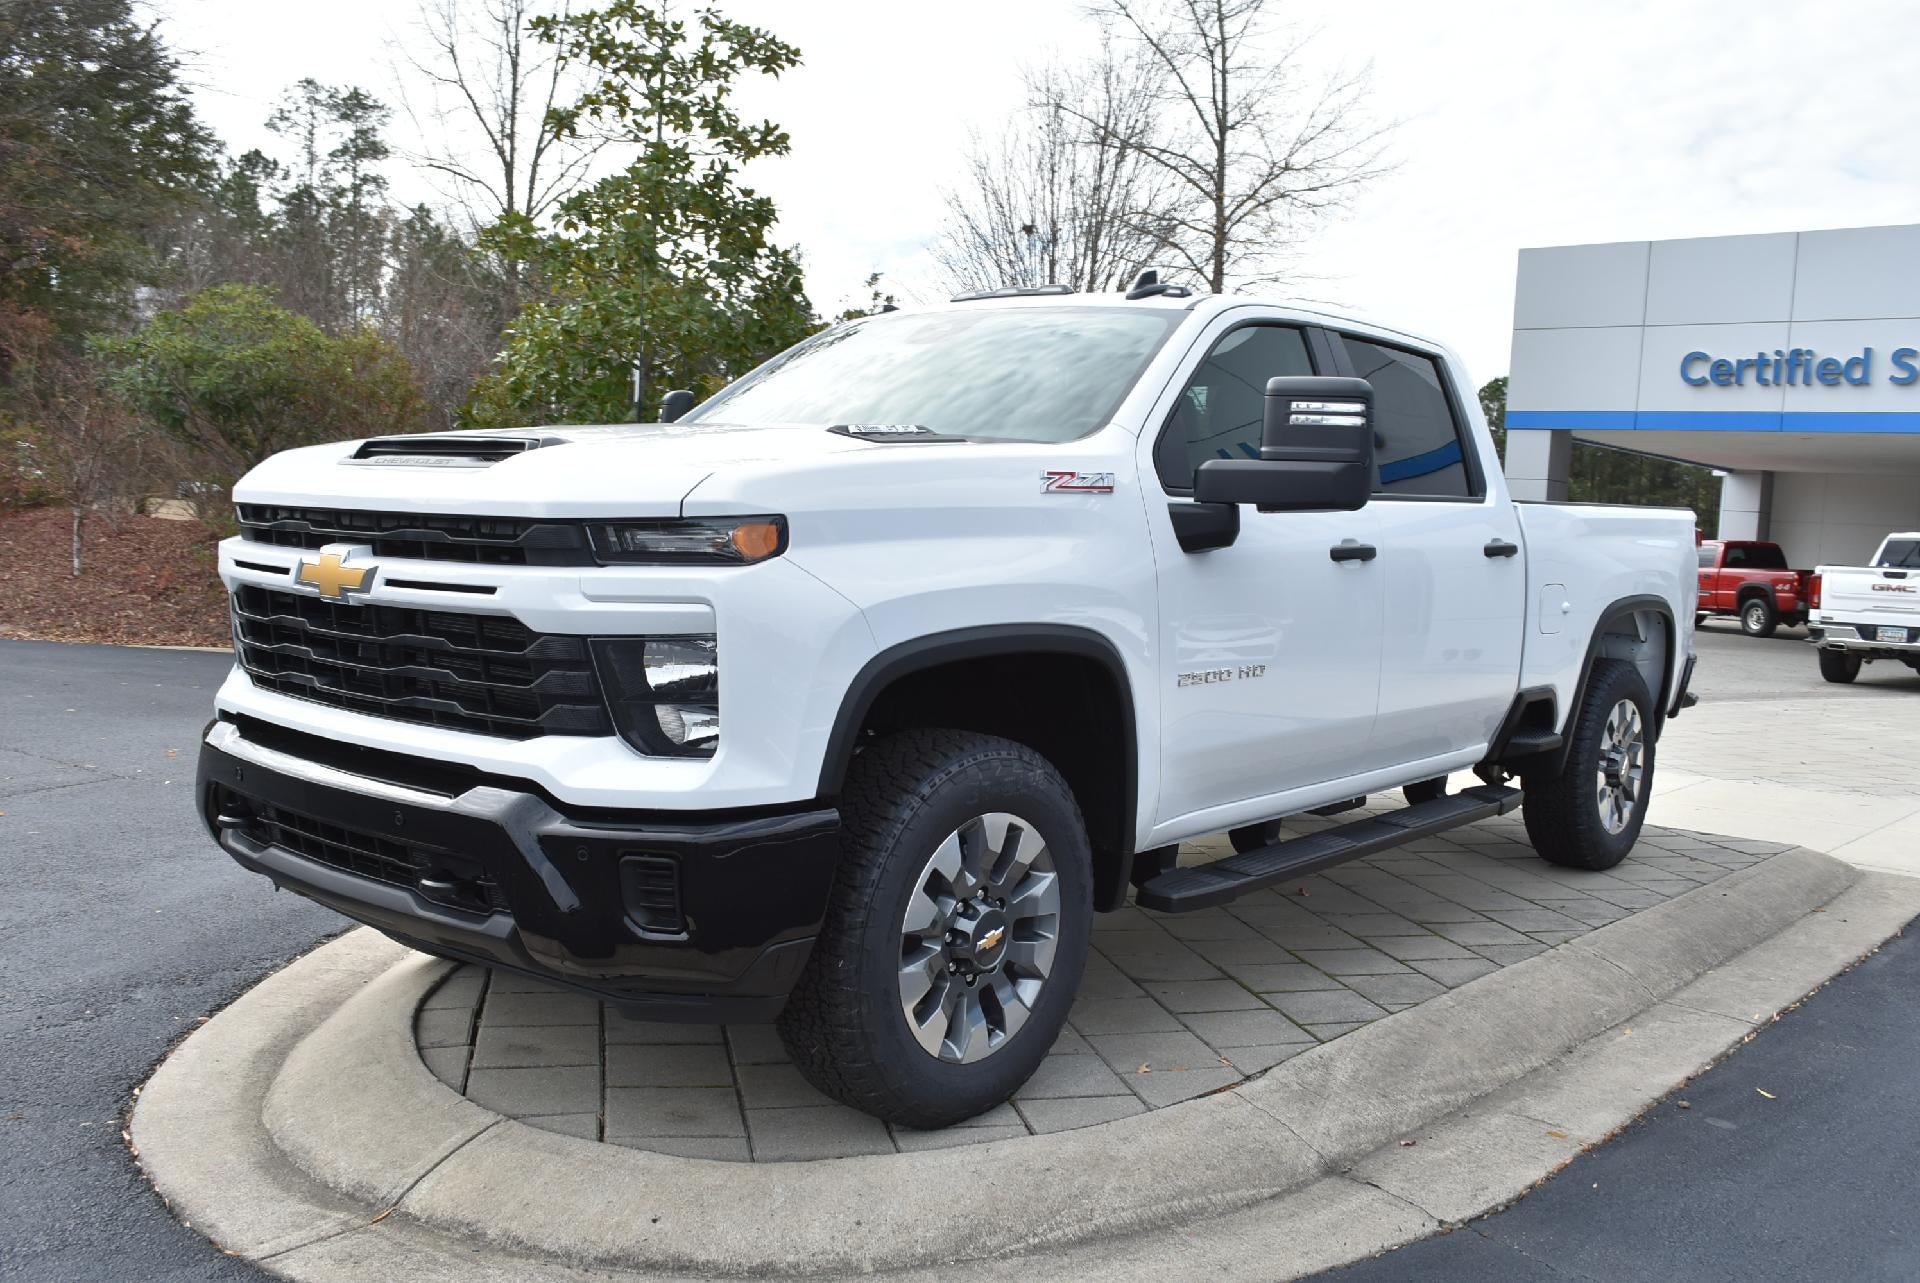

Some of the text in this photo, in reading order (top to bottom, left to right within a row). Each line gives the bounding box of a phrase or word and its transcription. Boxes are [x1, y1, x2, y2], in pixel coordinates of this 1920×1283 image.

[1680, 347, 1873, 386] Certified
[1040, 470, 1114, 495] Z71
[1872, 583, 1917, 593] GMC
[1177, 664, 1266, 688] 2500 HD
